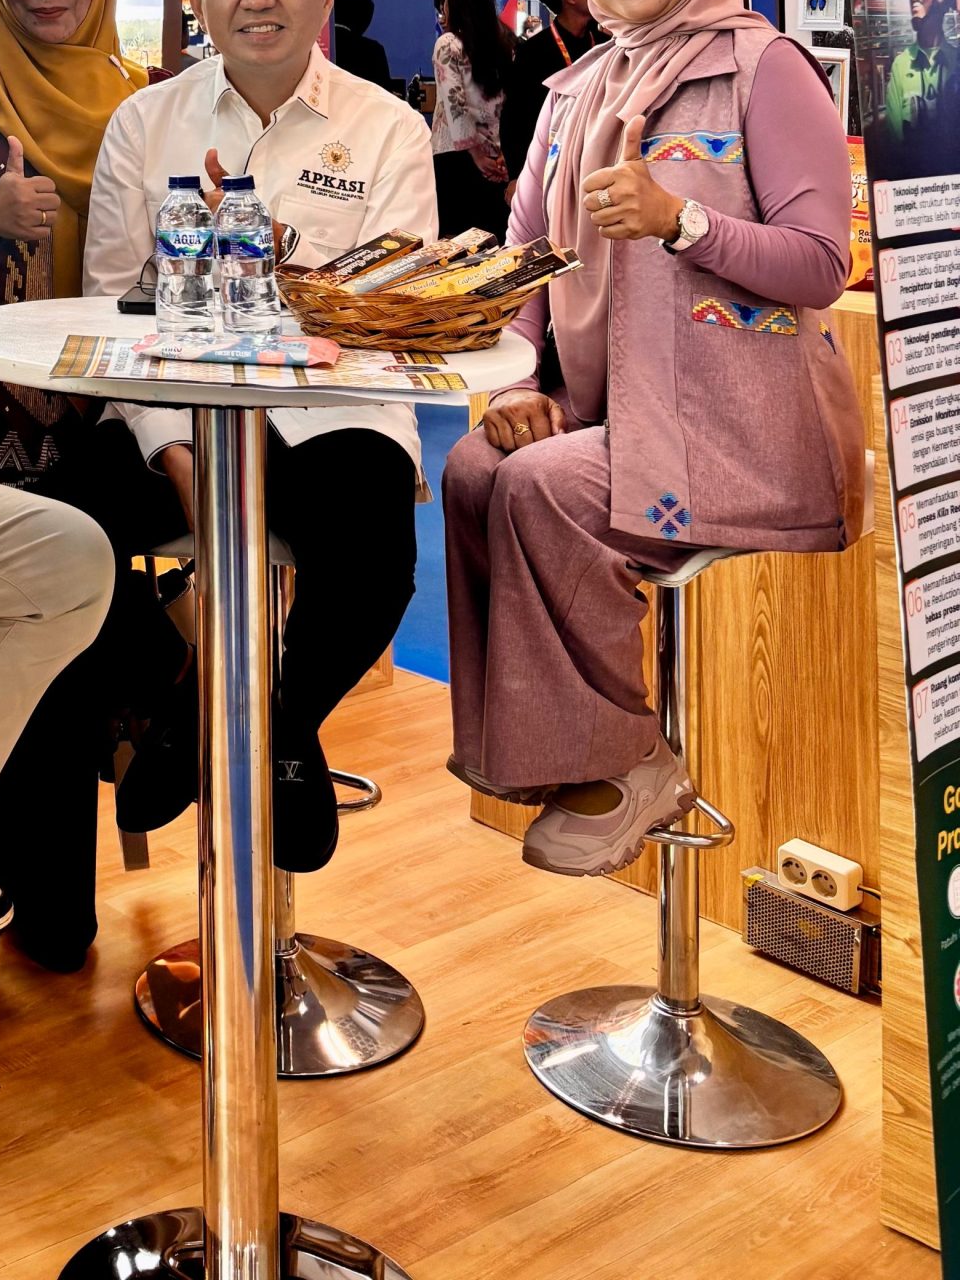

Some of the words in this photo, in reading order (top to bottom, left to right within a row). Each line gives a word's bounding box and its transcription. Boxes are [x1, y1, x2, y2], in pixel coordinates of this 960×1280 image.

[298, 169, 366, 194] APKASI
[920, 182, 950, 197] pendingin
[173, 234, 202, 246] AQUA
